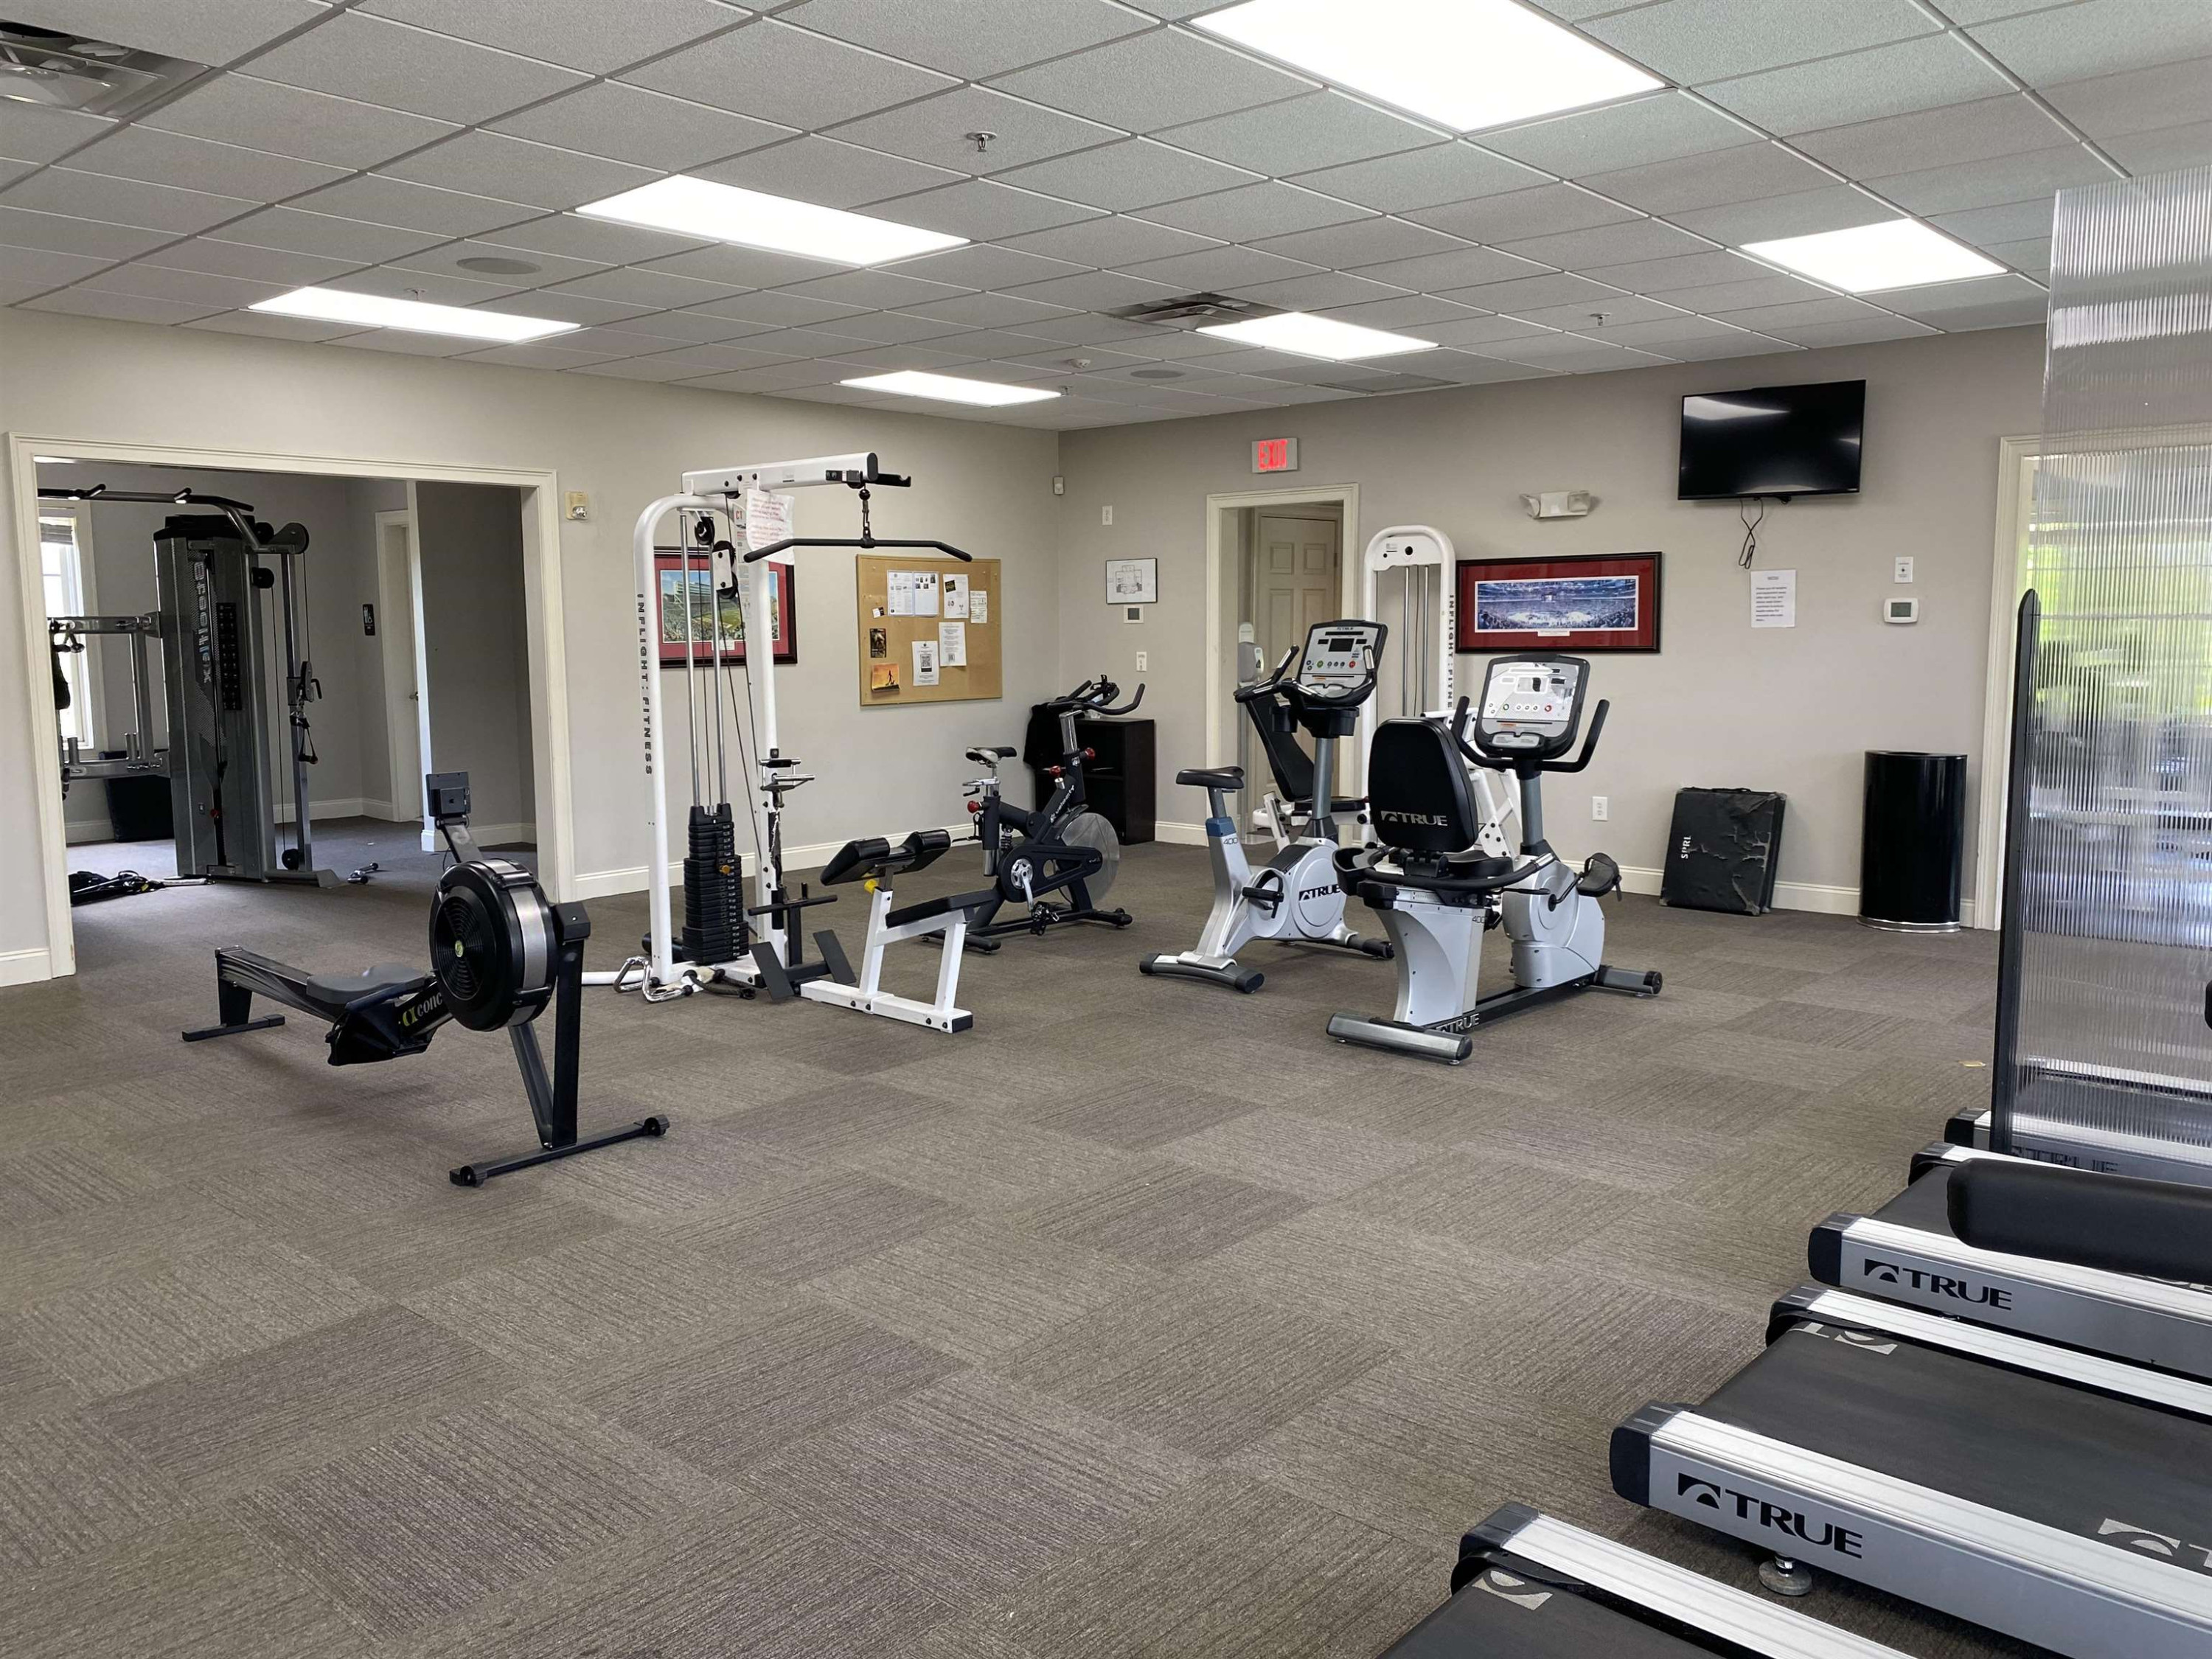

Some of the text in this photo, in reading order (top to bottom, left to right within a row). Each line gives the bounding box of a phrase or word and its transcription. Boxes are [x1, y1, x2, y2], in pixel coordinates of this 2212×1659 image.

[1258, 439, 1287, 469] EXIT
[642, 697, 653, 775] FITNESS
[1397, 812, 1448, 826] TRUE
[1223, 837, 1239, 845] 400
[1309, 884, 1340, 898] TRUE
[1447, 1013, 1480, 1032] TRUE
[1902, 1267, 2012, 1311] TRUE
[1725, 1489, 1863, 1559] TRUE
